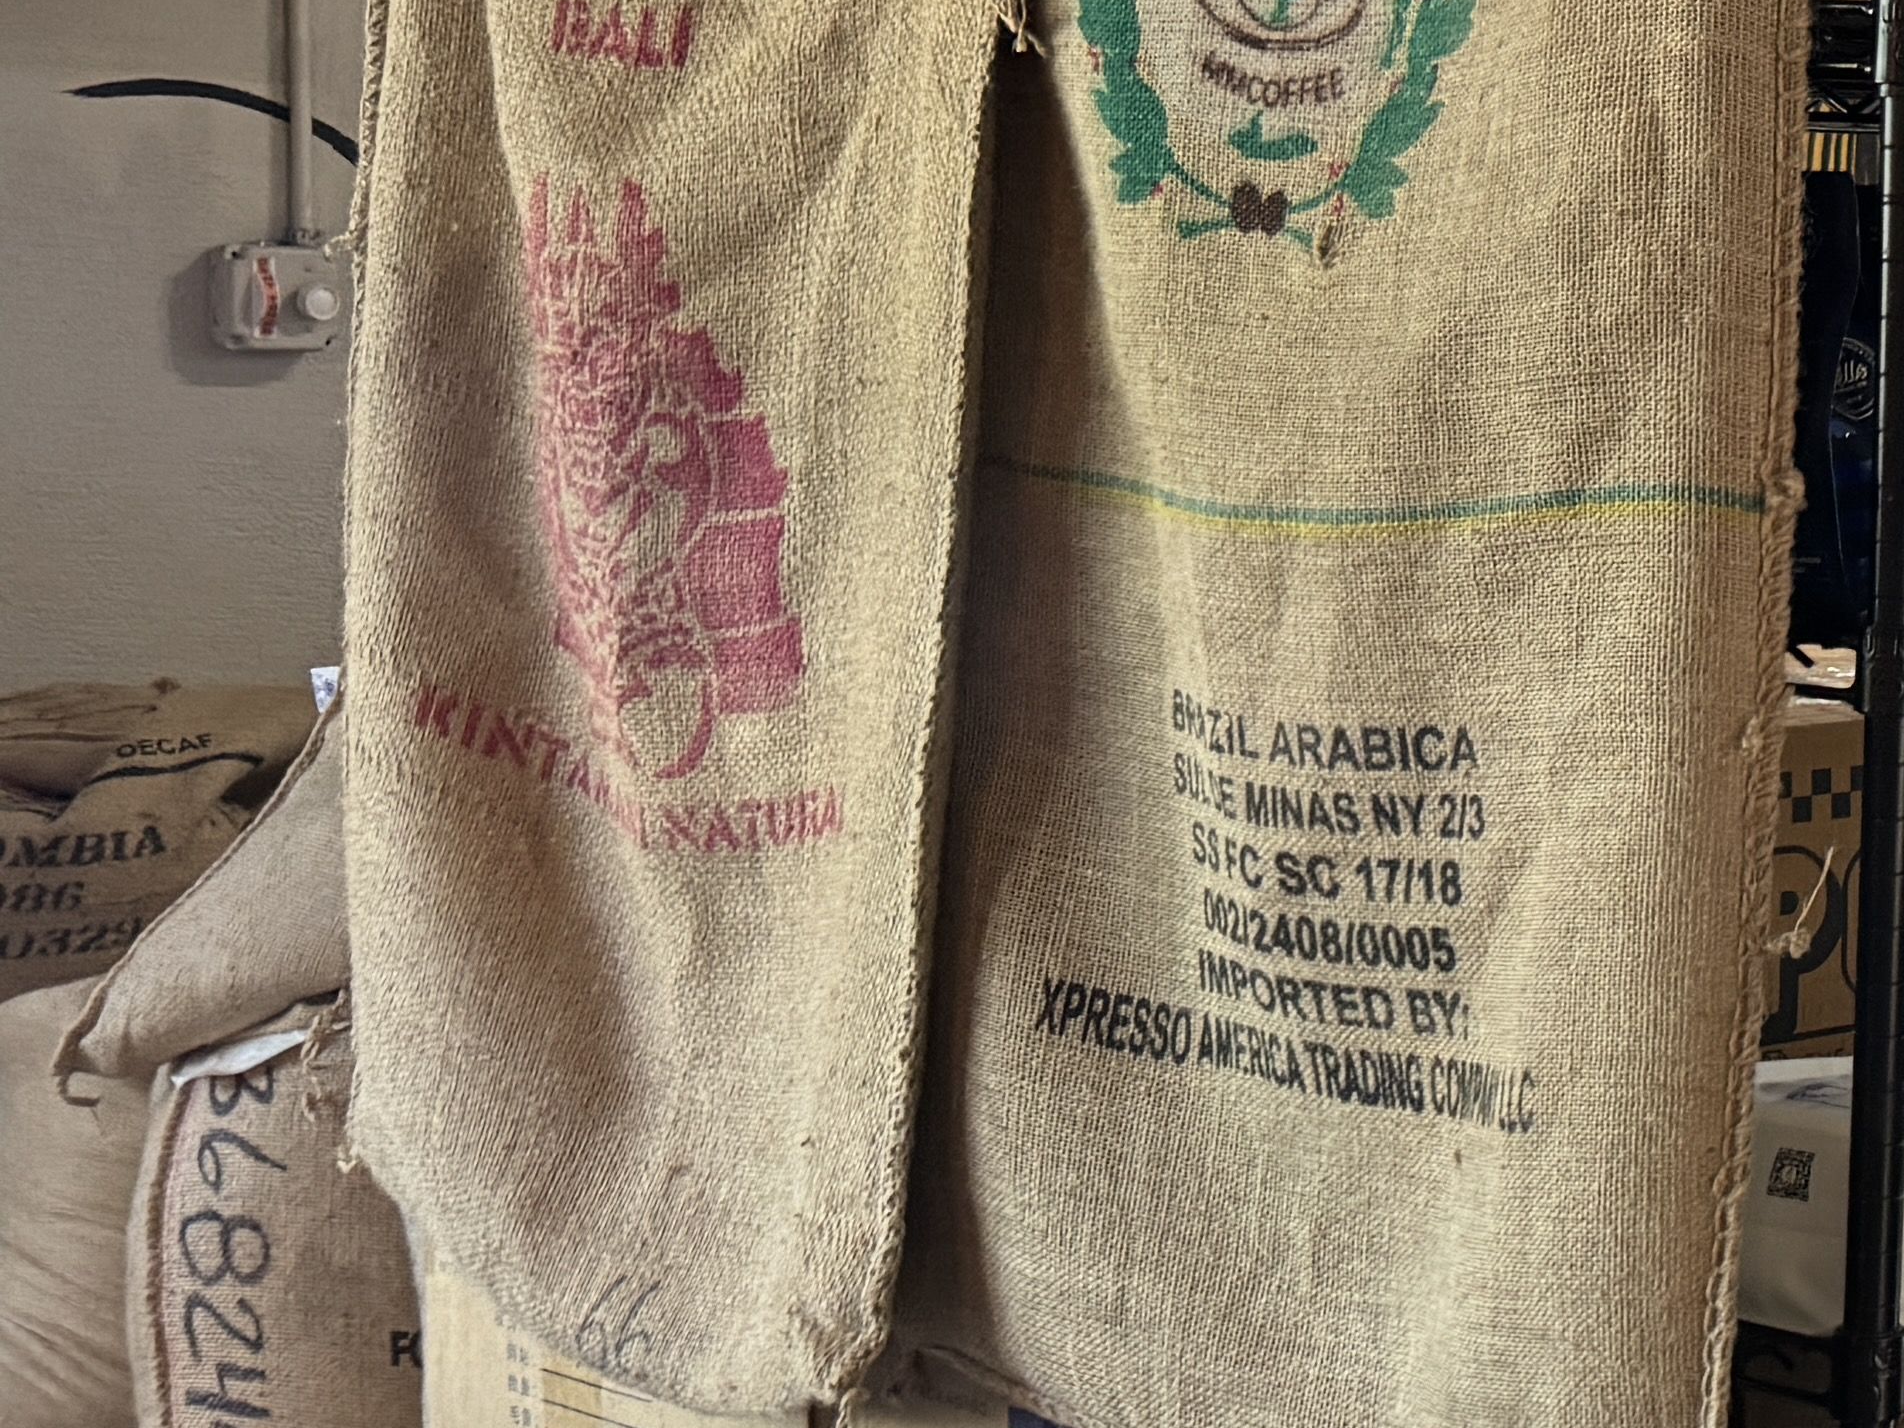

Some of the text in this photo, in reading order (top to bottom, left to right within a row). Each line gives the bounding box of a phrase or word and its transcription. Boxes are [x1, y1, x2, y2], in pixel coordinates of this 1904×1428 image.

[1171, 687, 1479, 774] BRAZIL ARABICA
[1244, 778, 1362, 837] MINAS
[1371, 793, 1425, 838] NY
[1437, 792, 1487, 841] 2/3
[1192, 819, 1464, 908] SS FC SC 17/18
[1202, 884, 1457, 974] 002/2408/0005
[1198, 947, 1397, 1031] IMPORTED
[1034, 972, 1195, 1066] XPRESSO
[1199, 1014, 1302, 1096] AMERICA
[1301, 1037, 1426, 1114] TRADING
